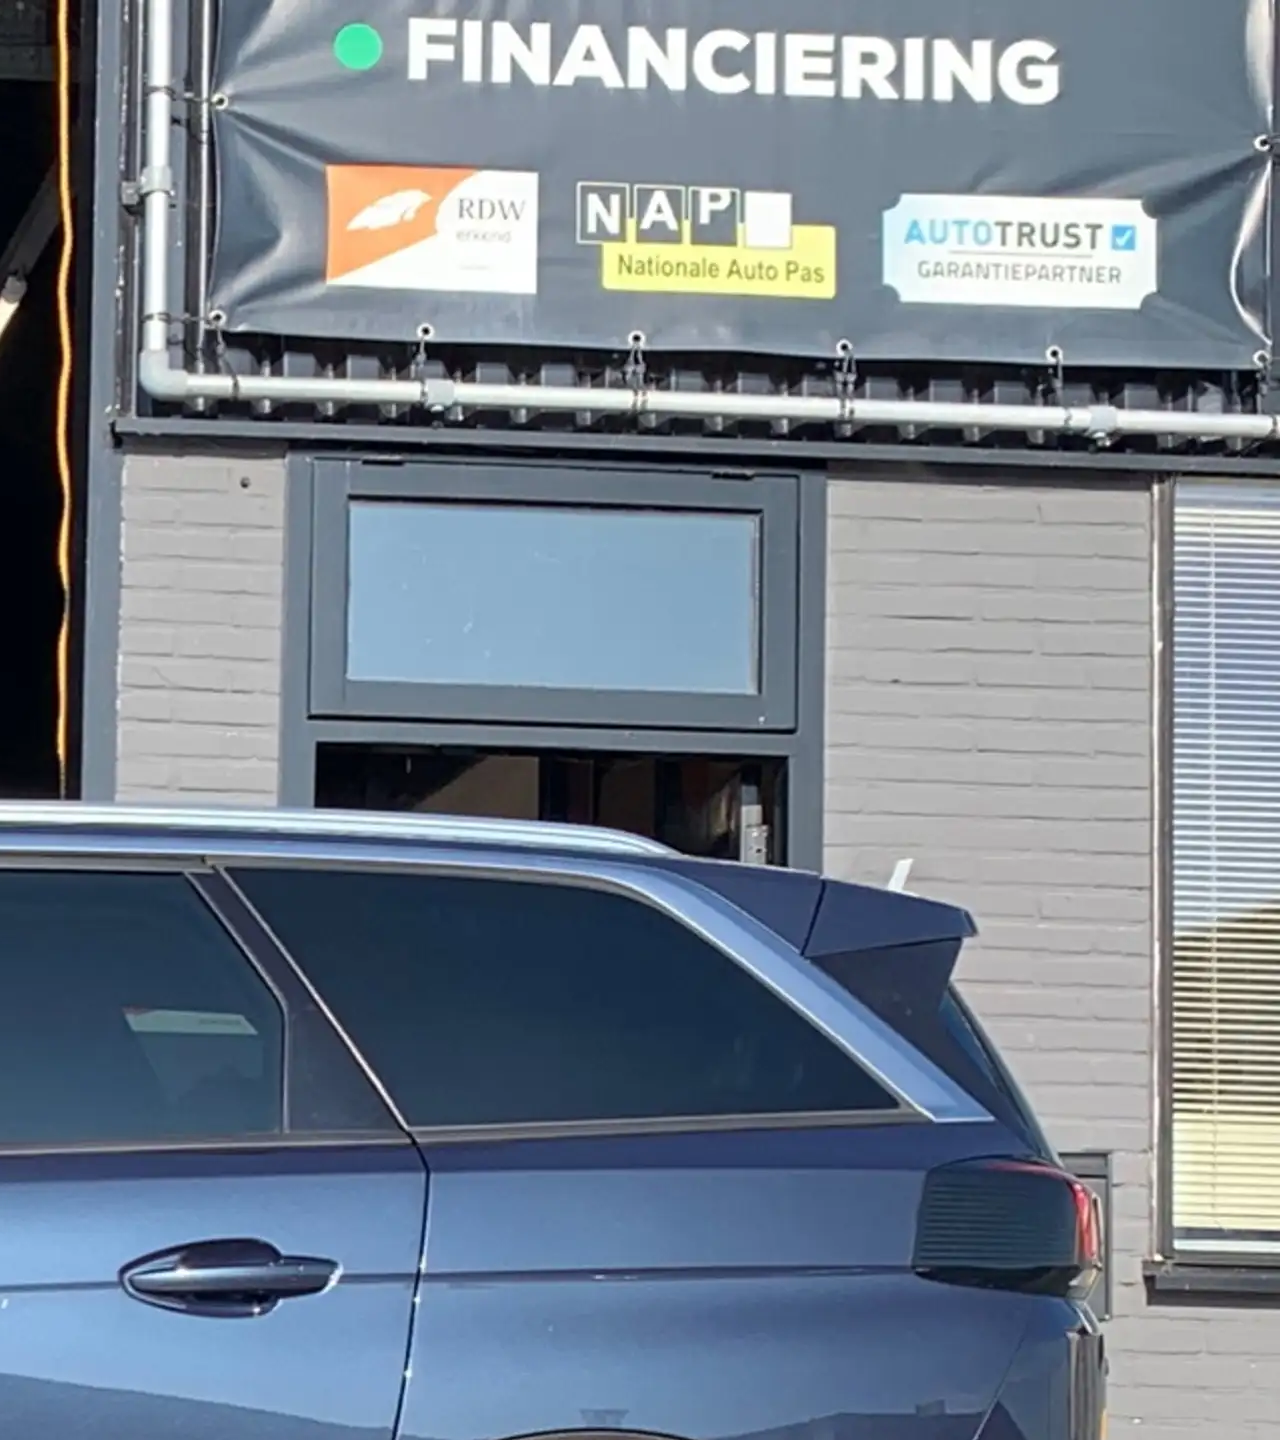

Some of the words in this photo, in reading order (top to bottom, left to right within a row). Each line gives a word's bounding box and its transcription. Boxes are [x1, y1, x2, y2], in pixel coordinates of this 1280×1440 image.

[407, 17, 1061, 106] FINANCIERING
[458, 198, 526, 221] RDW
[586, 189, 731, 235] NAP
[903, 219, 1104, 250] AUTOTRUST
[617, 254, 720, 279] Nationale
[726, 259, 779, 282] Auto
[785, 260, 825, 284] Pas
[917, 260, 1122, 284] GARANTIEPARTNER
